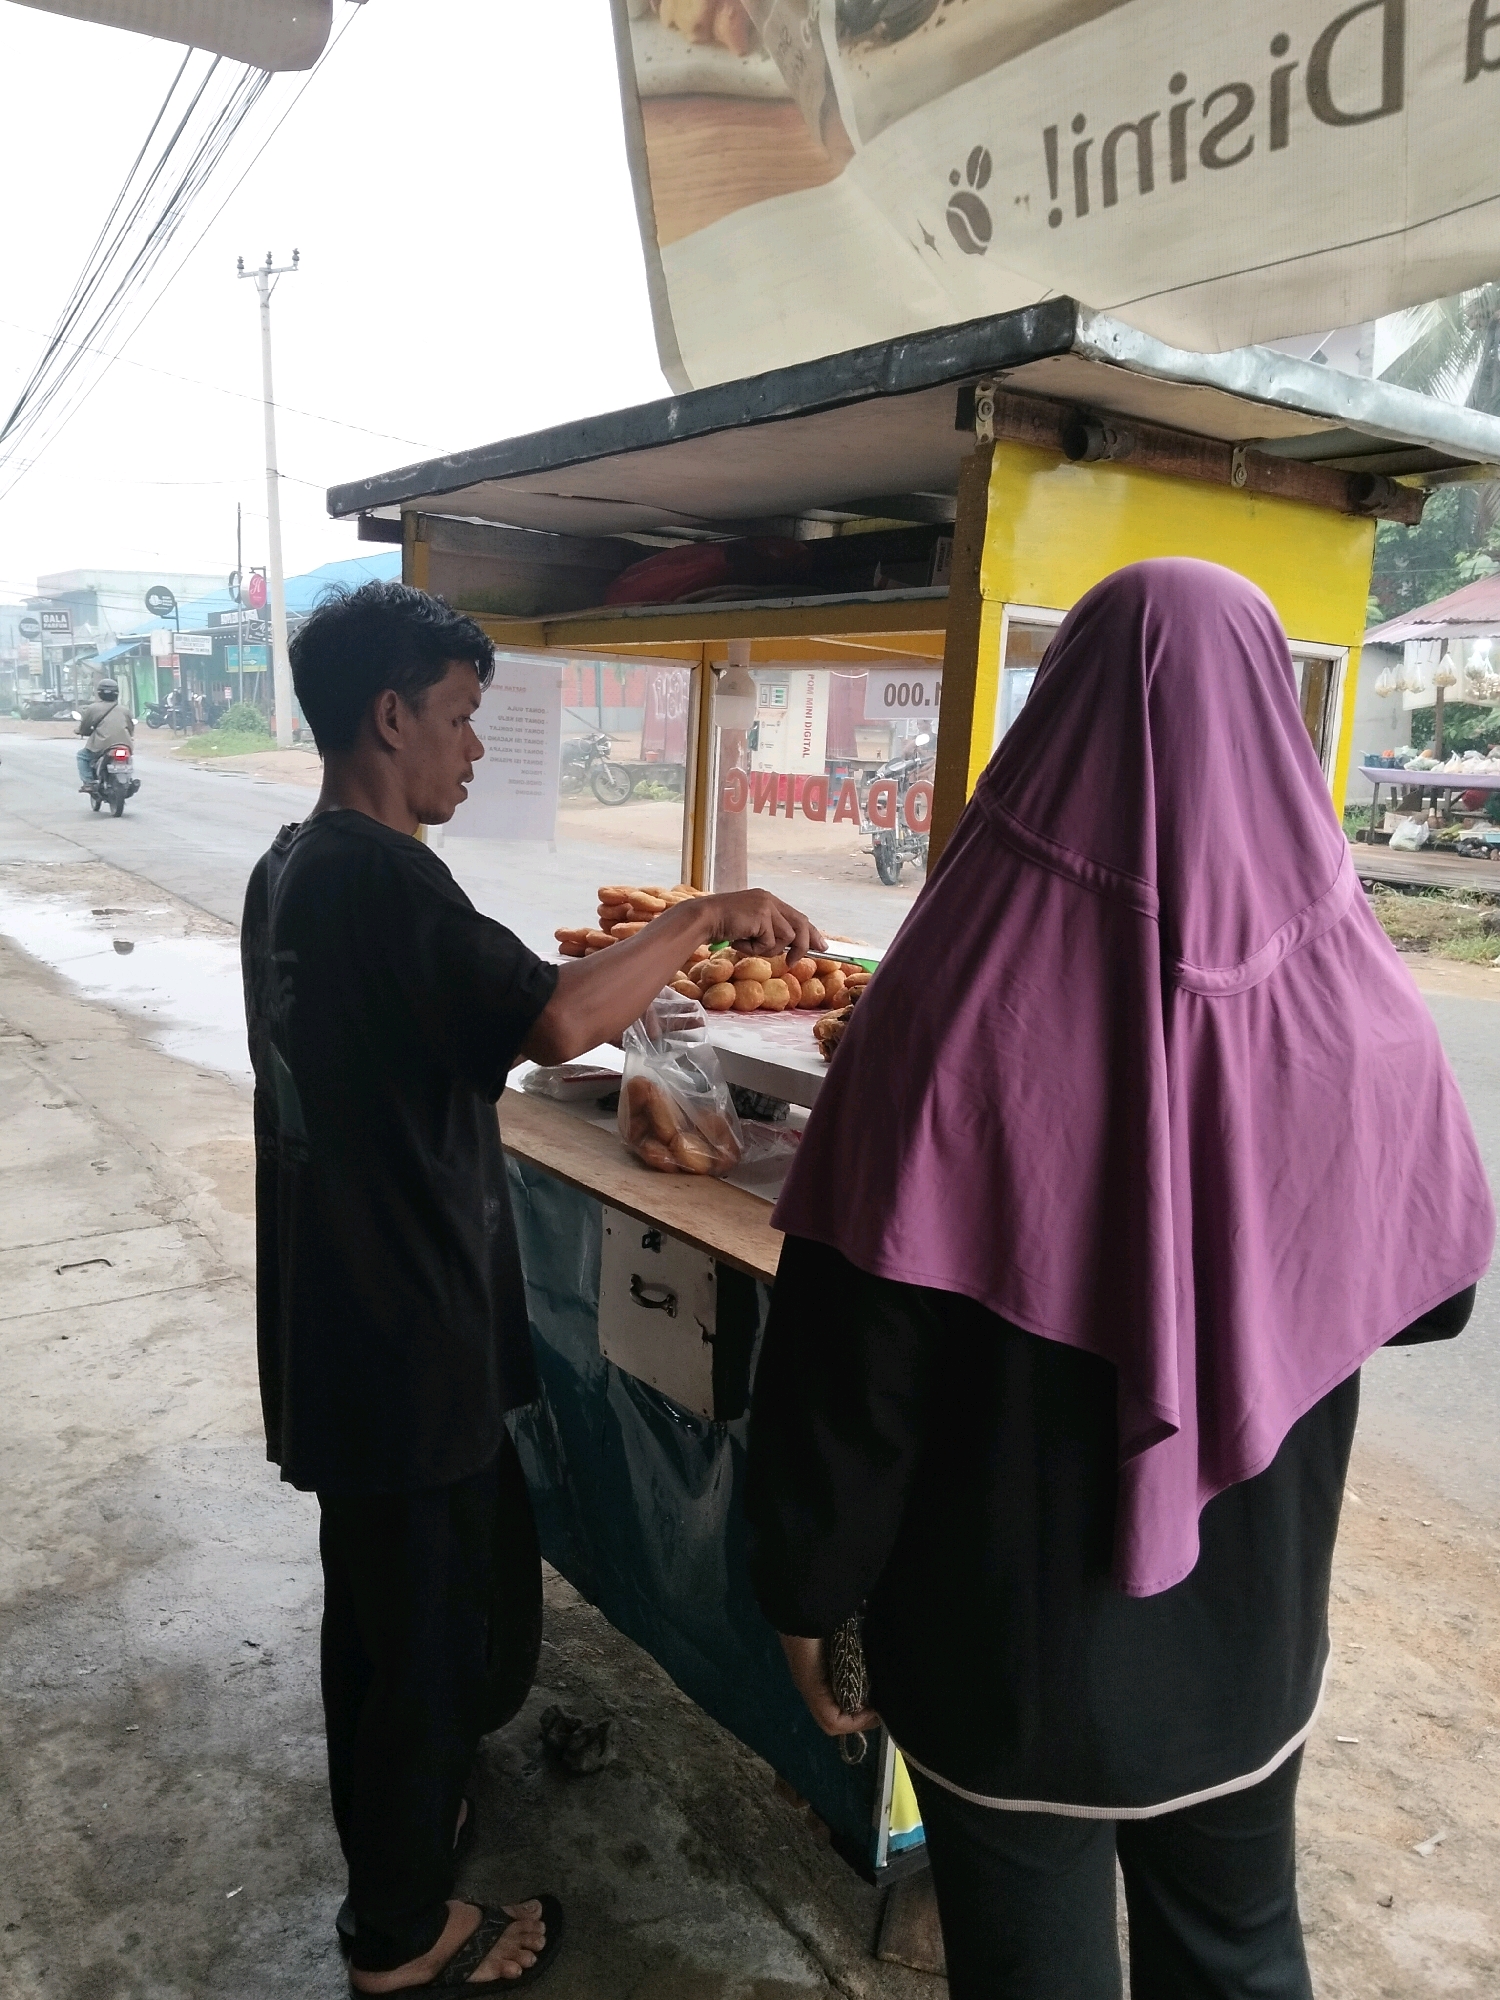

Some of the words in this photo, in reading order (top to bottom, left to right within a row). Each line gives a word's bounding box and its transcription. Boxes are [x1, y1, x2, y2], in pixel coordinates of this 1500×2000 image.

[43, 614, 67, 623] GALA
[806, 673, 815, 695] POM
[805, 697, 813, 719] MINI
[802, 721, 812, 759] DIGITAL
